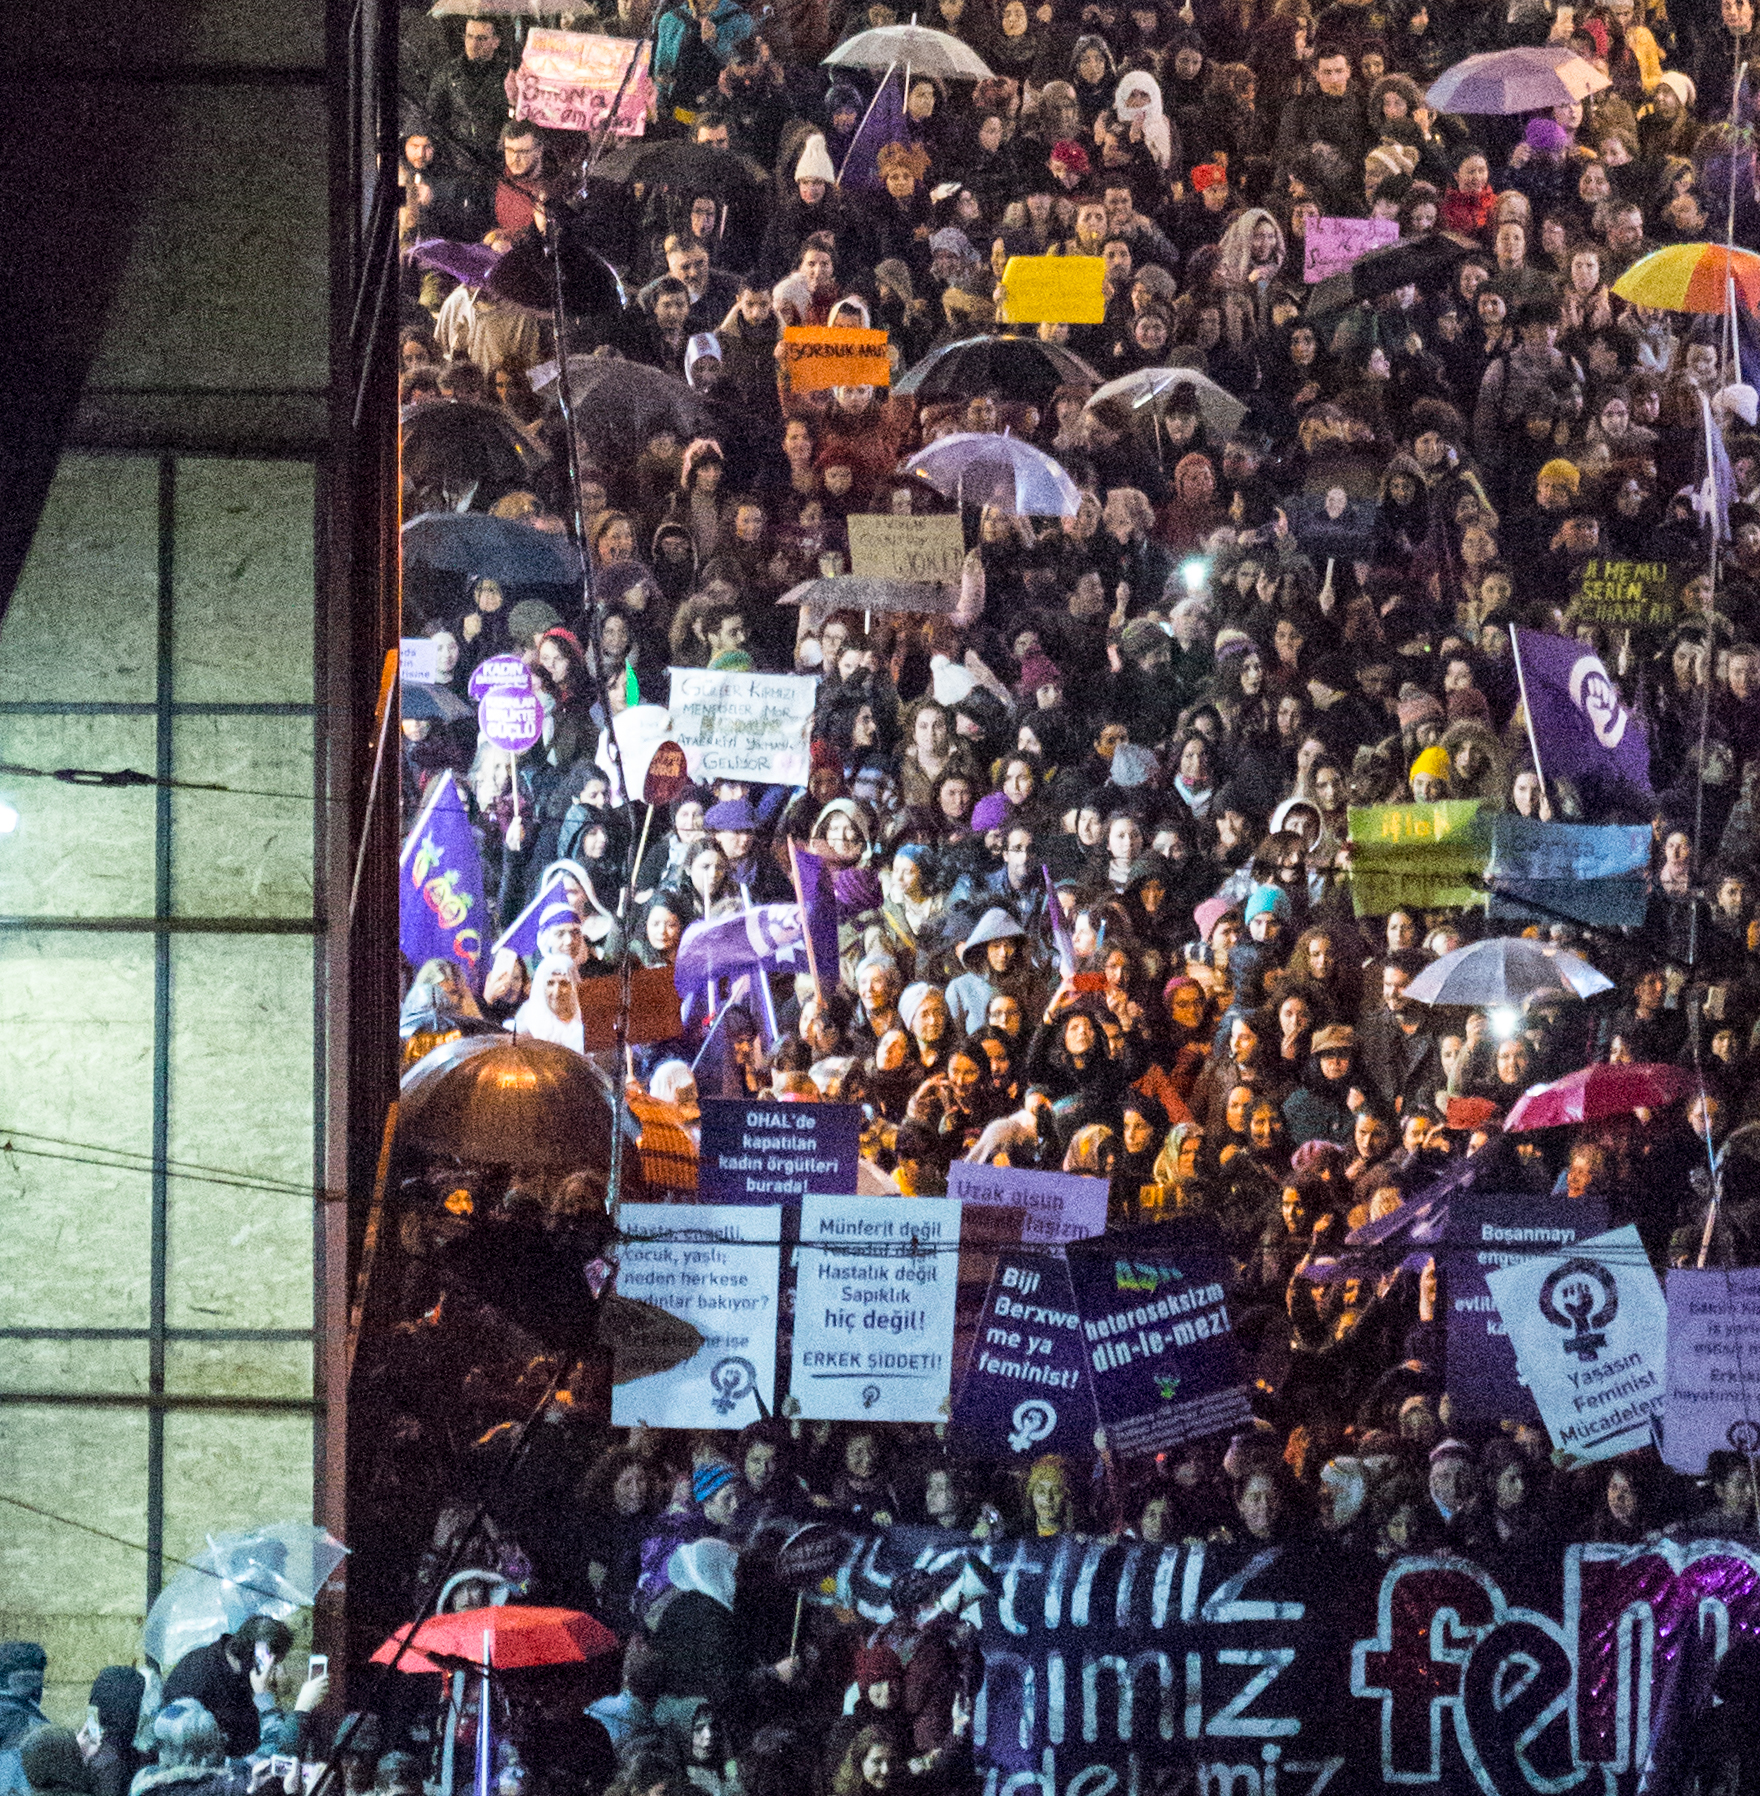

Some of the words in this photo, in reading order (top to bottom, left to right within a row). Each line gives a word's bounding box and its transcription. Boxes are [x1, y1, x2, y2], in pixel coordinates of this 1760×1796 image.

[746, 1112, 816, 1130] OHAL'de
[741, 1133, 817, 1155] kapatılan
[718, 1155, 763, 1172] kadın
[765, 1155, 839, 1176] örgütleri
[746, 1176, 810, 1195] burada!
[819, 1217, 894, 1239] Münferit
[899, 1220, 942, 1241] değil
[1481, 1222, 1576, 1246] Boşanmayı
[623, 1270, 669, 1287] neden
[675, 1270, 748, 1287] herkese
[817, 1263, 889, 1281] Hastalık
[894, 1265, 939, 1285] değil
[697, 1294, 770, 1312] bakıyor?
[841, 1286, 911, 1306] Sapıklık
[824, 1308, 855, 1334] hiç
[861, 1310, 927, 1333] değil!
[993, 1294, 1080, 1331] Berxwe
[1084, 1282, 1225, 1342] heteroseksizm
[985, 1327, 1022, 1349] me
[1026, 1335, 1054, 1356] ya
[802, 1350, 861, 1368] ERKEK
[977, 1351, 1080, 1390] feminist!
[1572, 1370, 1659, 1414] Feminist
